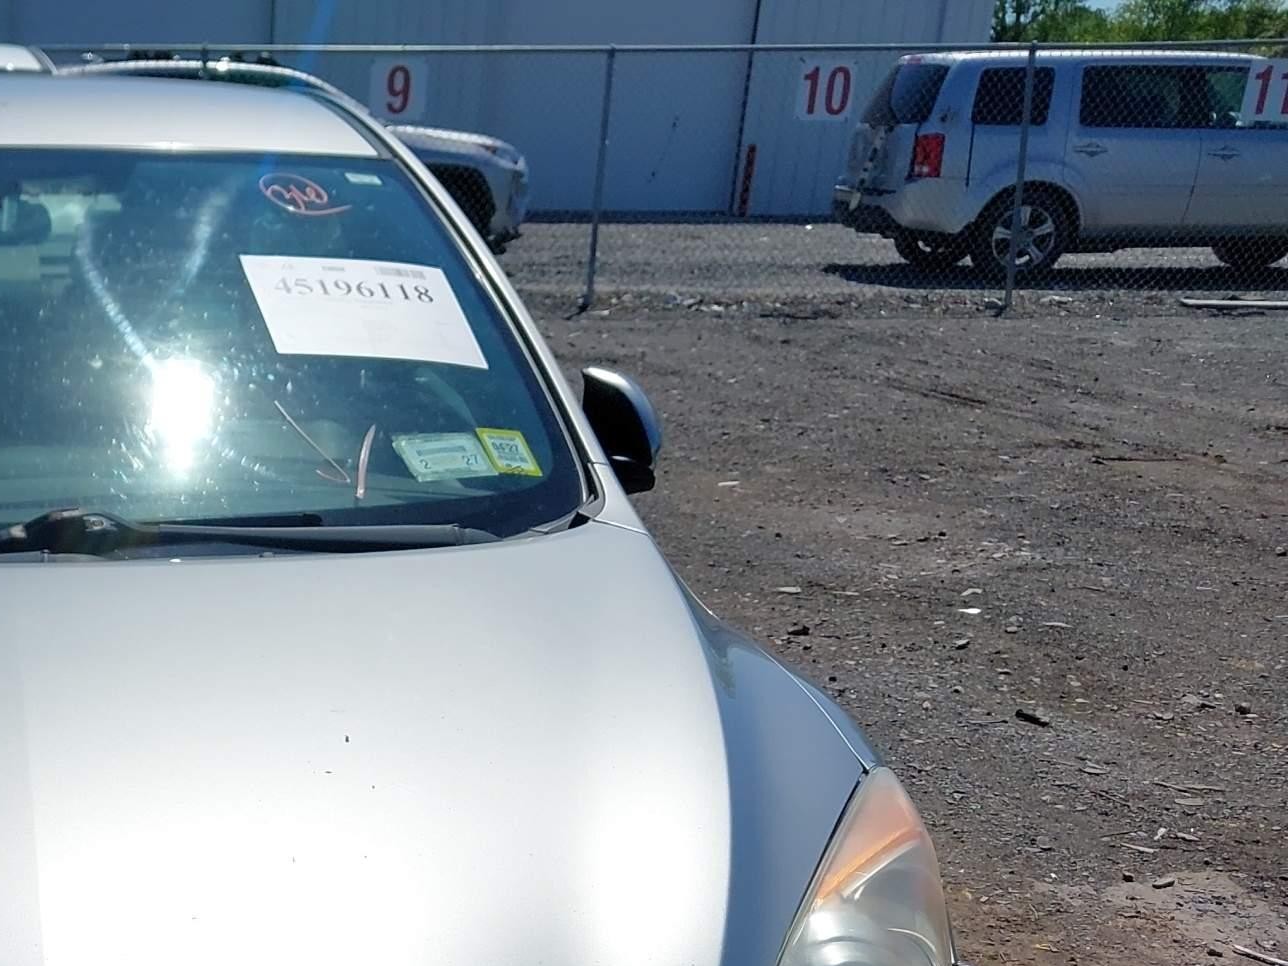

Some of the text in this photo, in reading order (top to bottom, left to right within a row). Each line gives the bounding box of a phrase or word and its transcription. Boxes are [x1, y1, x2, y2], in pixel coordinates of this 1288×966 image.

[386, 64, 410, 114] 9
[803, 65, 851, 116] 10
[273, 276, 434, 304] 45196118
